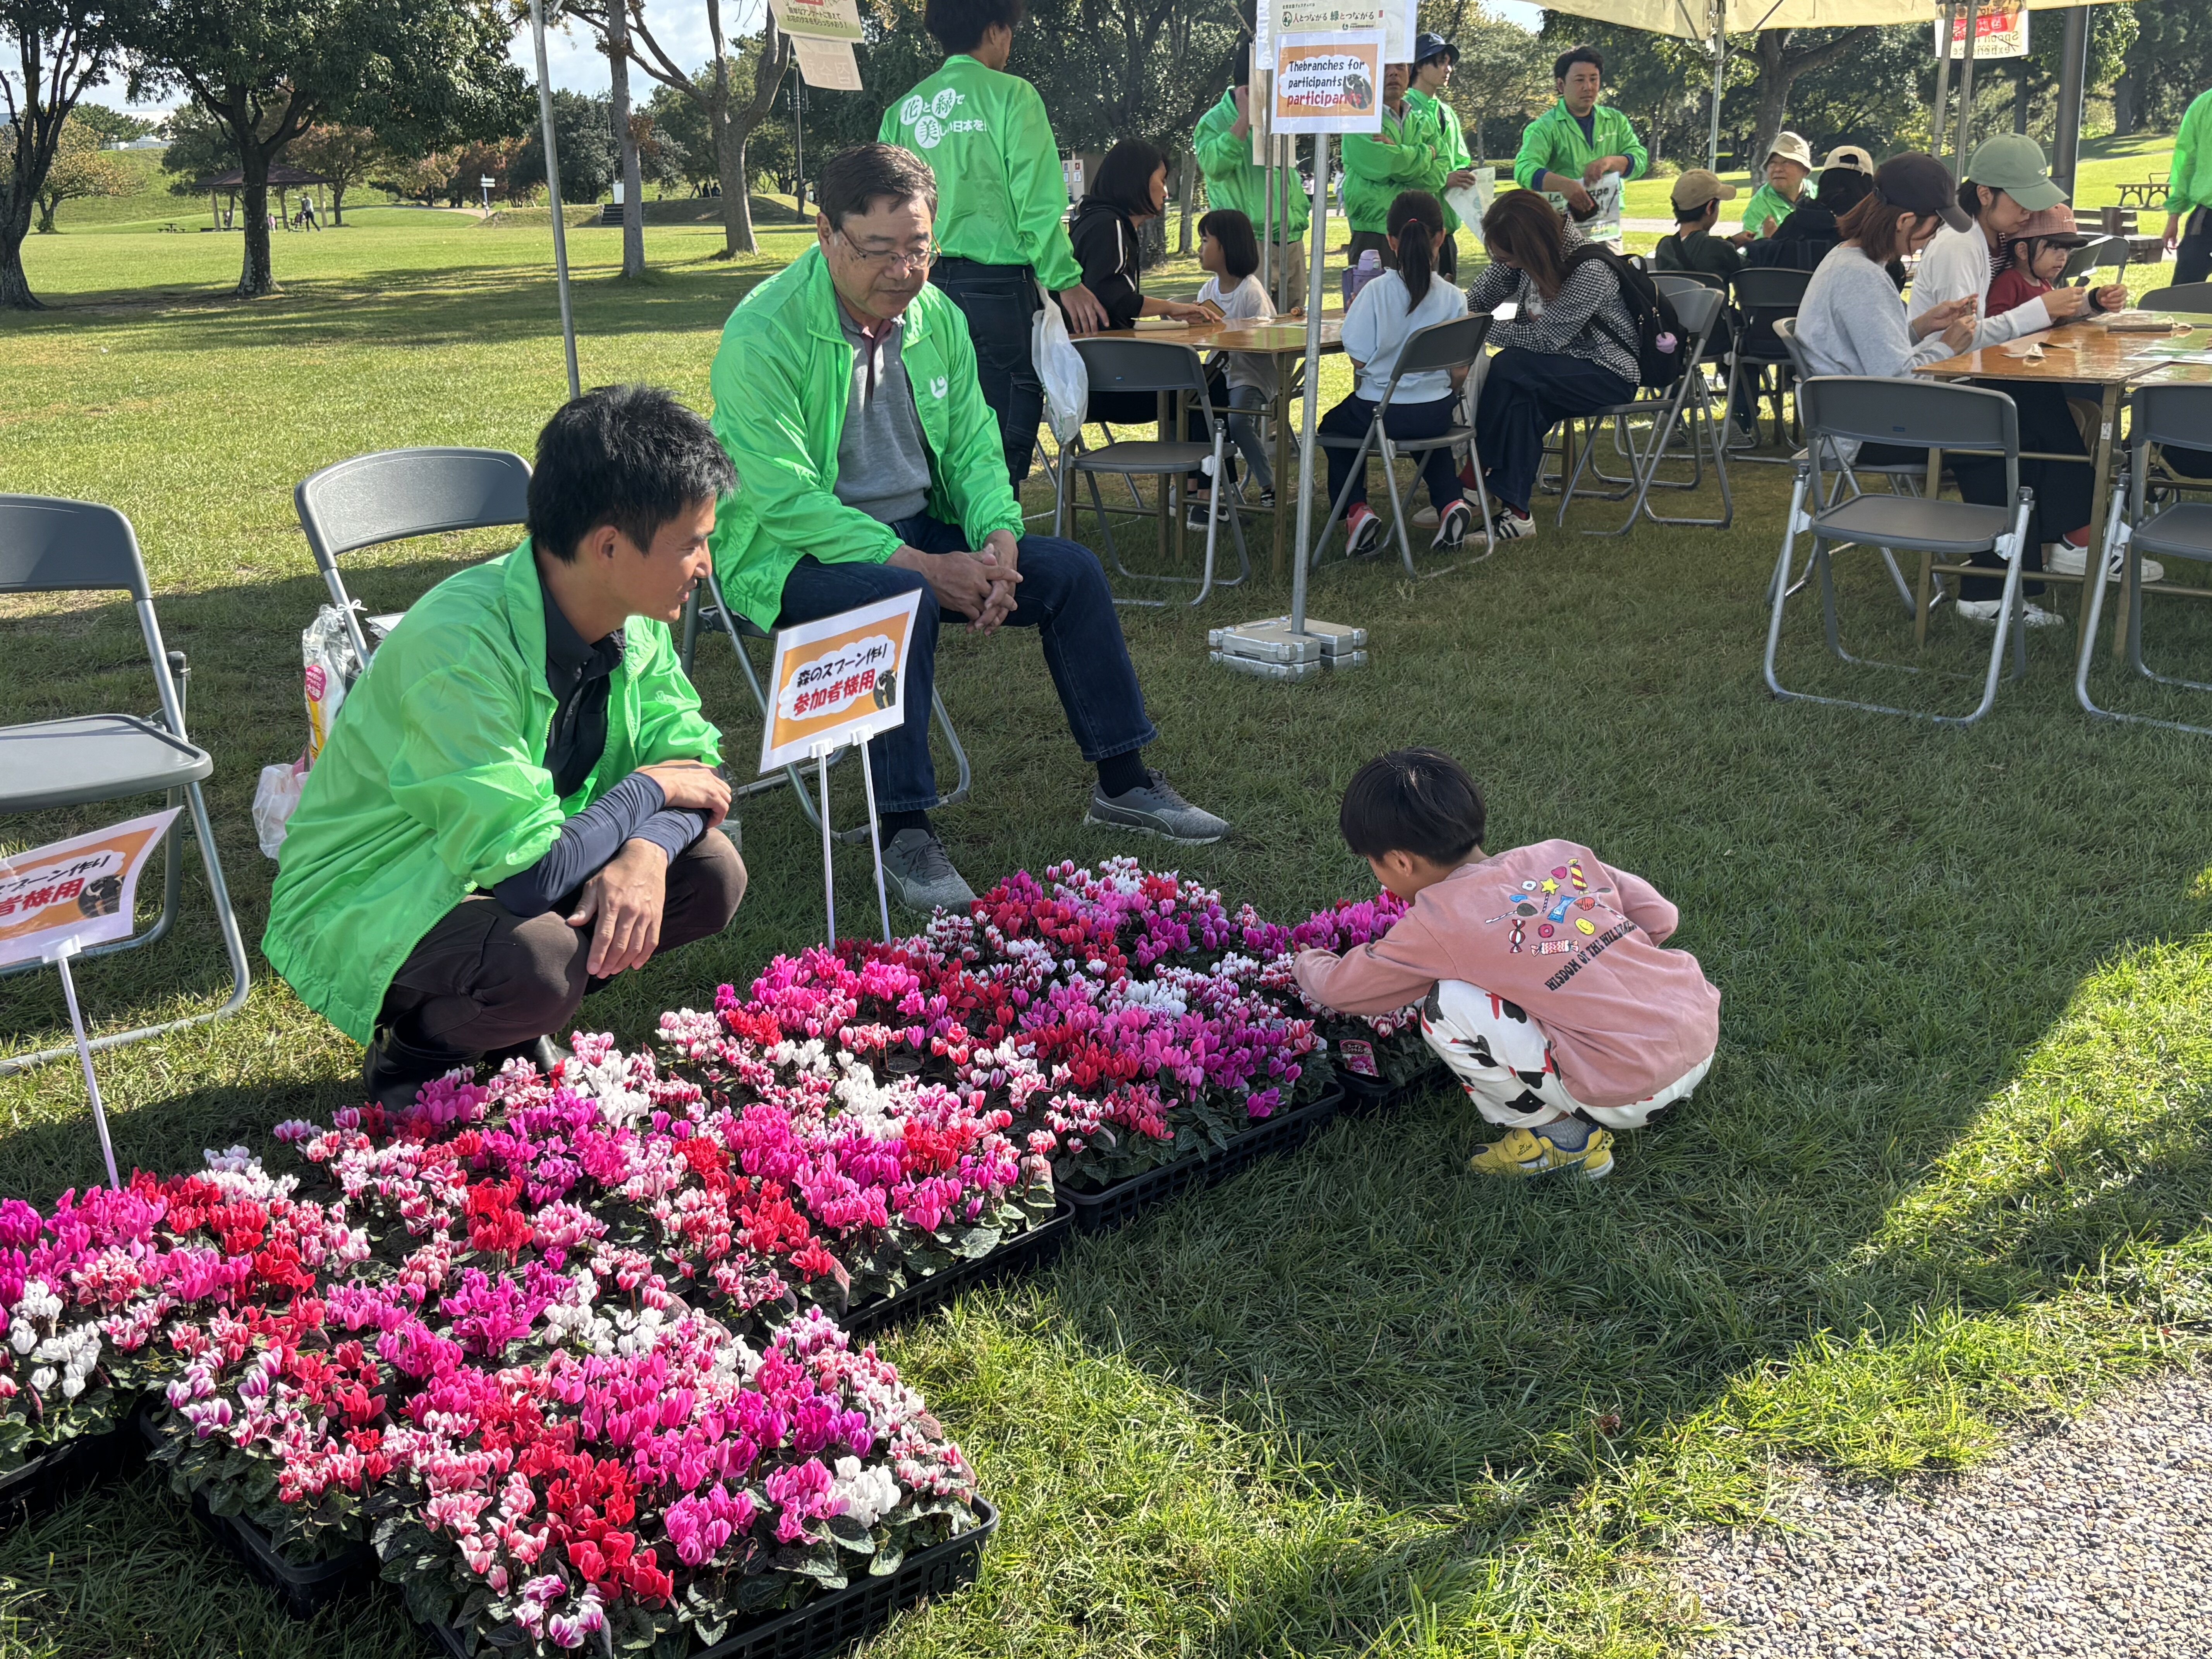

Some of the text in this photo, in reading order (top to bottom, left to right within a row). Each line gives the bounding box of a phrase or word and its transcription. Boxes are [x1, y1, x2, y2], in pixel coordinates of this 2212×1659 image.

[1289, 59, 1365, 72] Thebranches for
[1286, 90, 1362, 107] participants
[797, 643, 887, 687] 森のスプーン作り
[794, 668, 875, 716] 参加者様用
[1544, 959, 1582, 991] WISDOM
[1579, 951, 1590, 964] OF
[1586, 940, 1605, 957] THE
